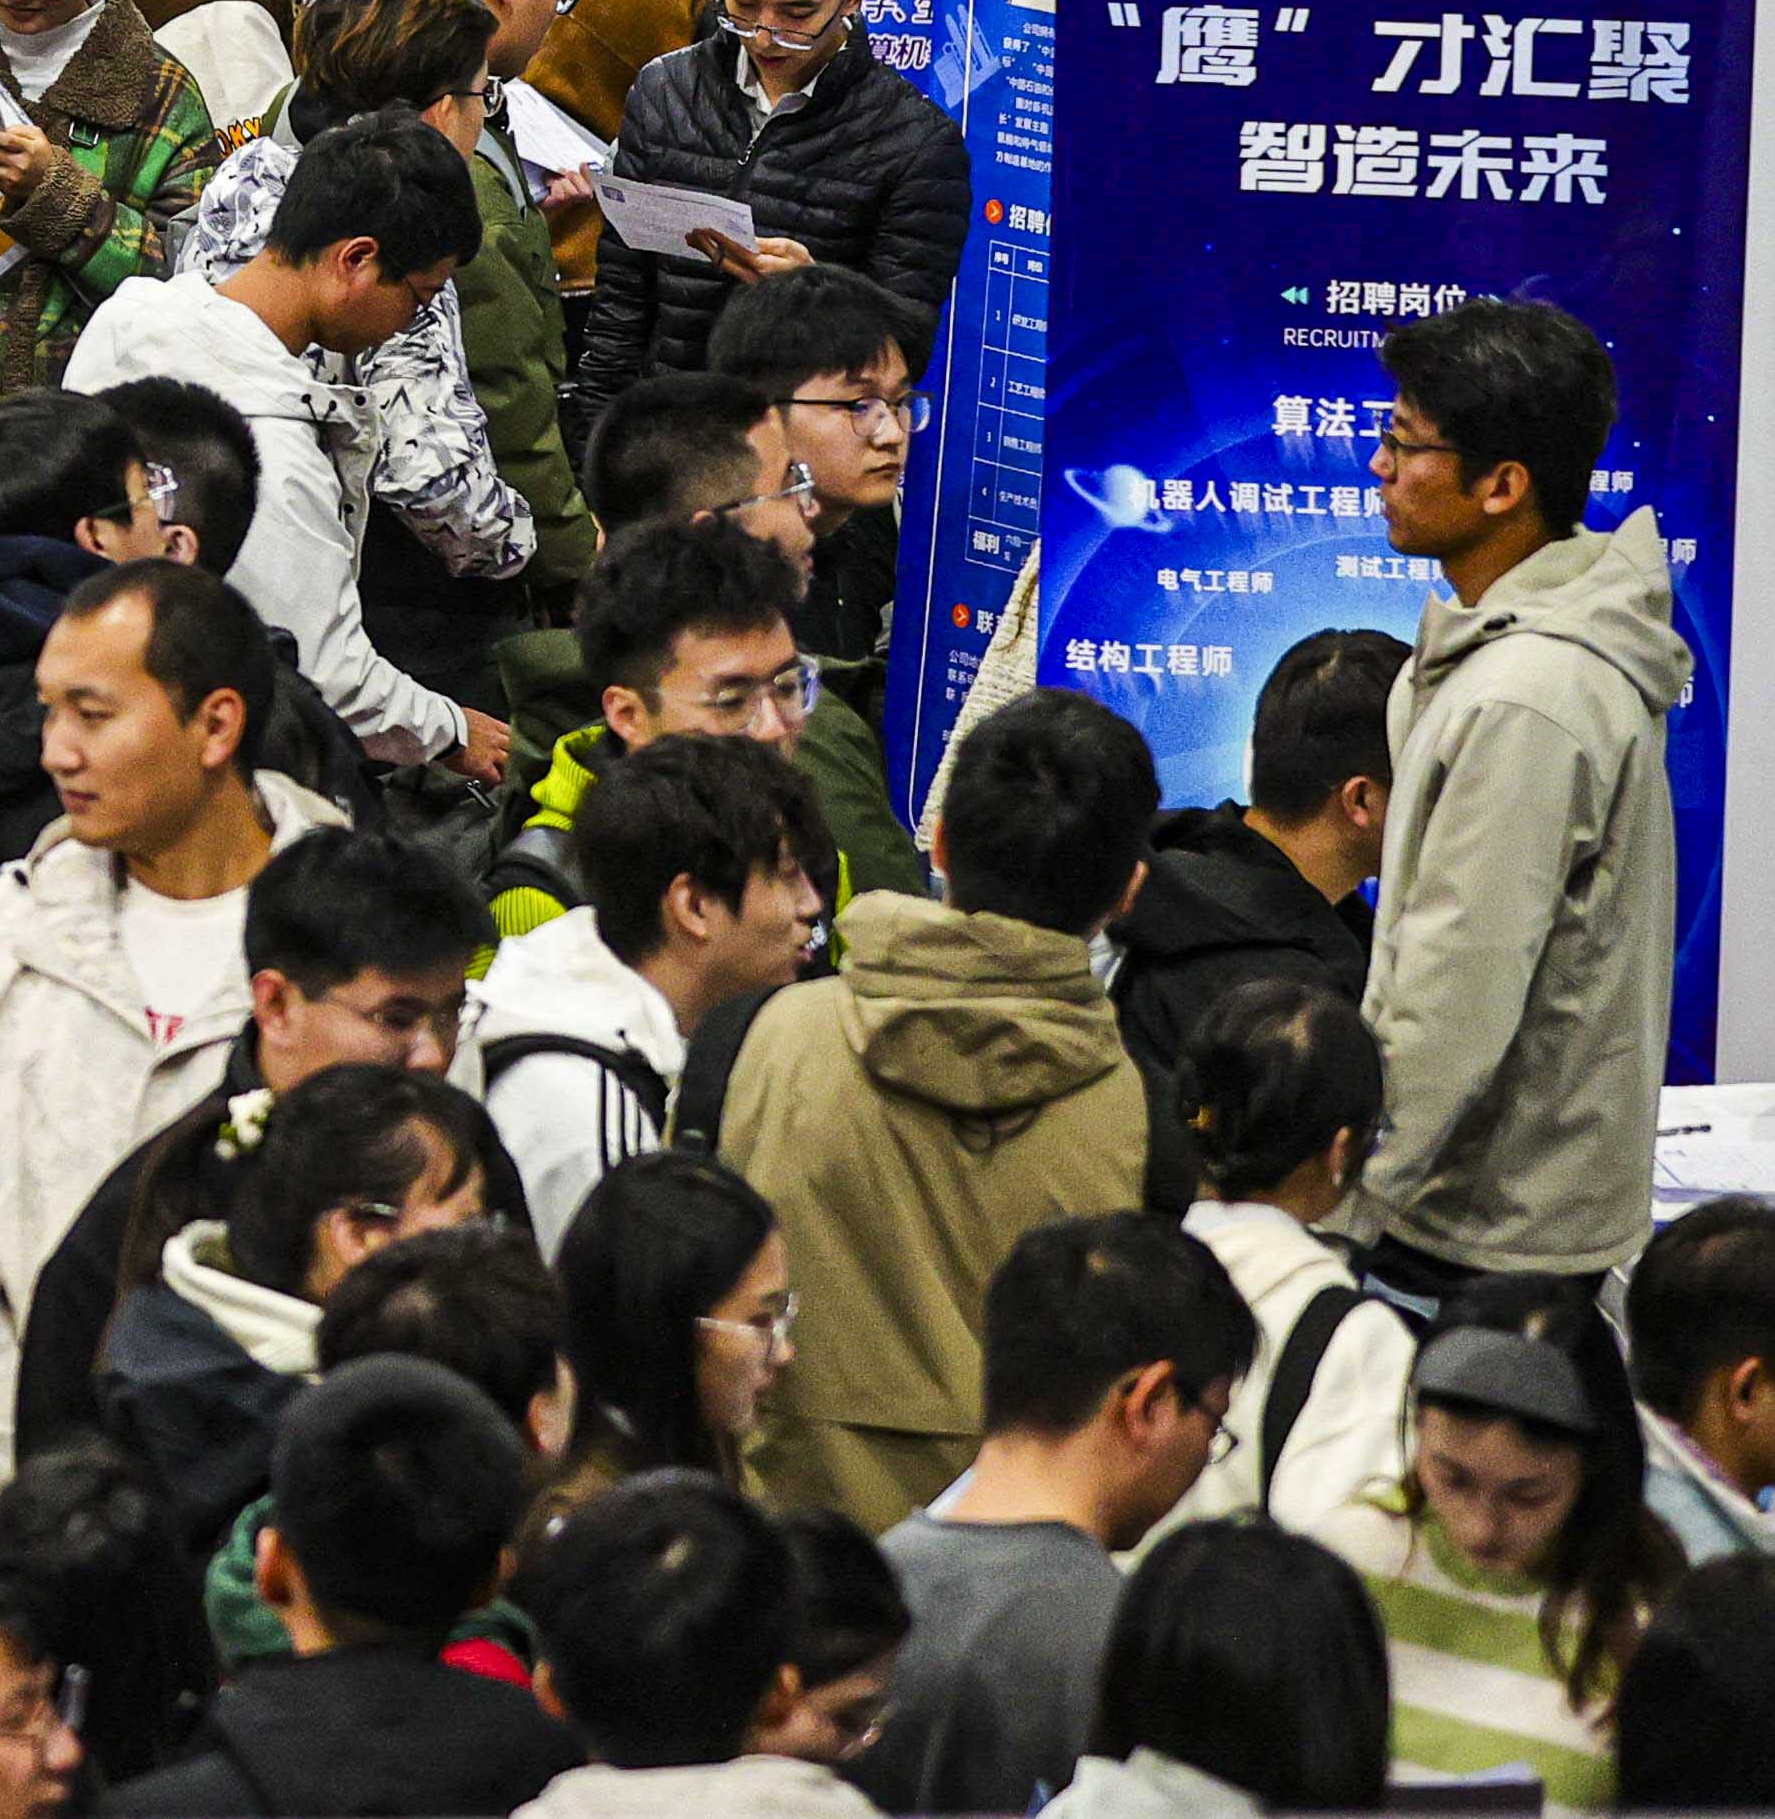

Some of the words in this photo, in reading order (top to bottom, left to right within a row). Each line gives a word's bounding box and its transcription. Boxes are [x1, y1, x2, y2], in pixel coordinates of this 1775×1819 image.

[1238, 121, 1608, 205] 智造未来
[1009, 204, 1051, 236] 招聘
[1325, 280, 1467, 318] 招聘岗位
[971, 530, 1000, 556] 福利
[1156, 567, 1274, 594] 电气工程师
[976, 610, 1000, 635] 联
[1065, 638, 1233, 677] 结构工程师
